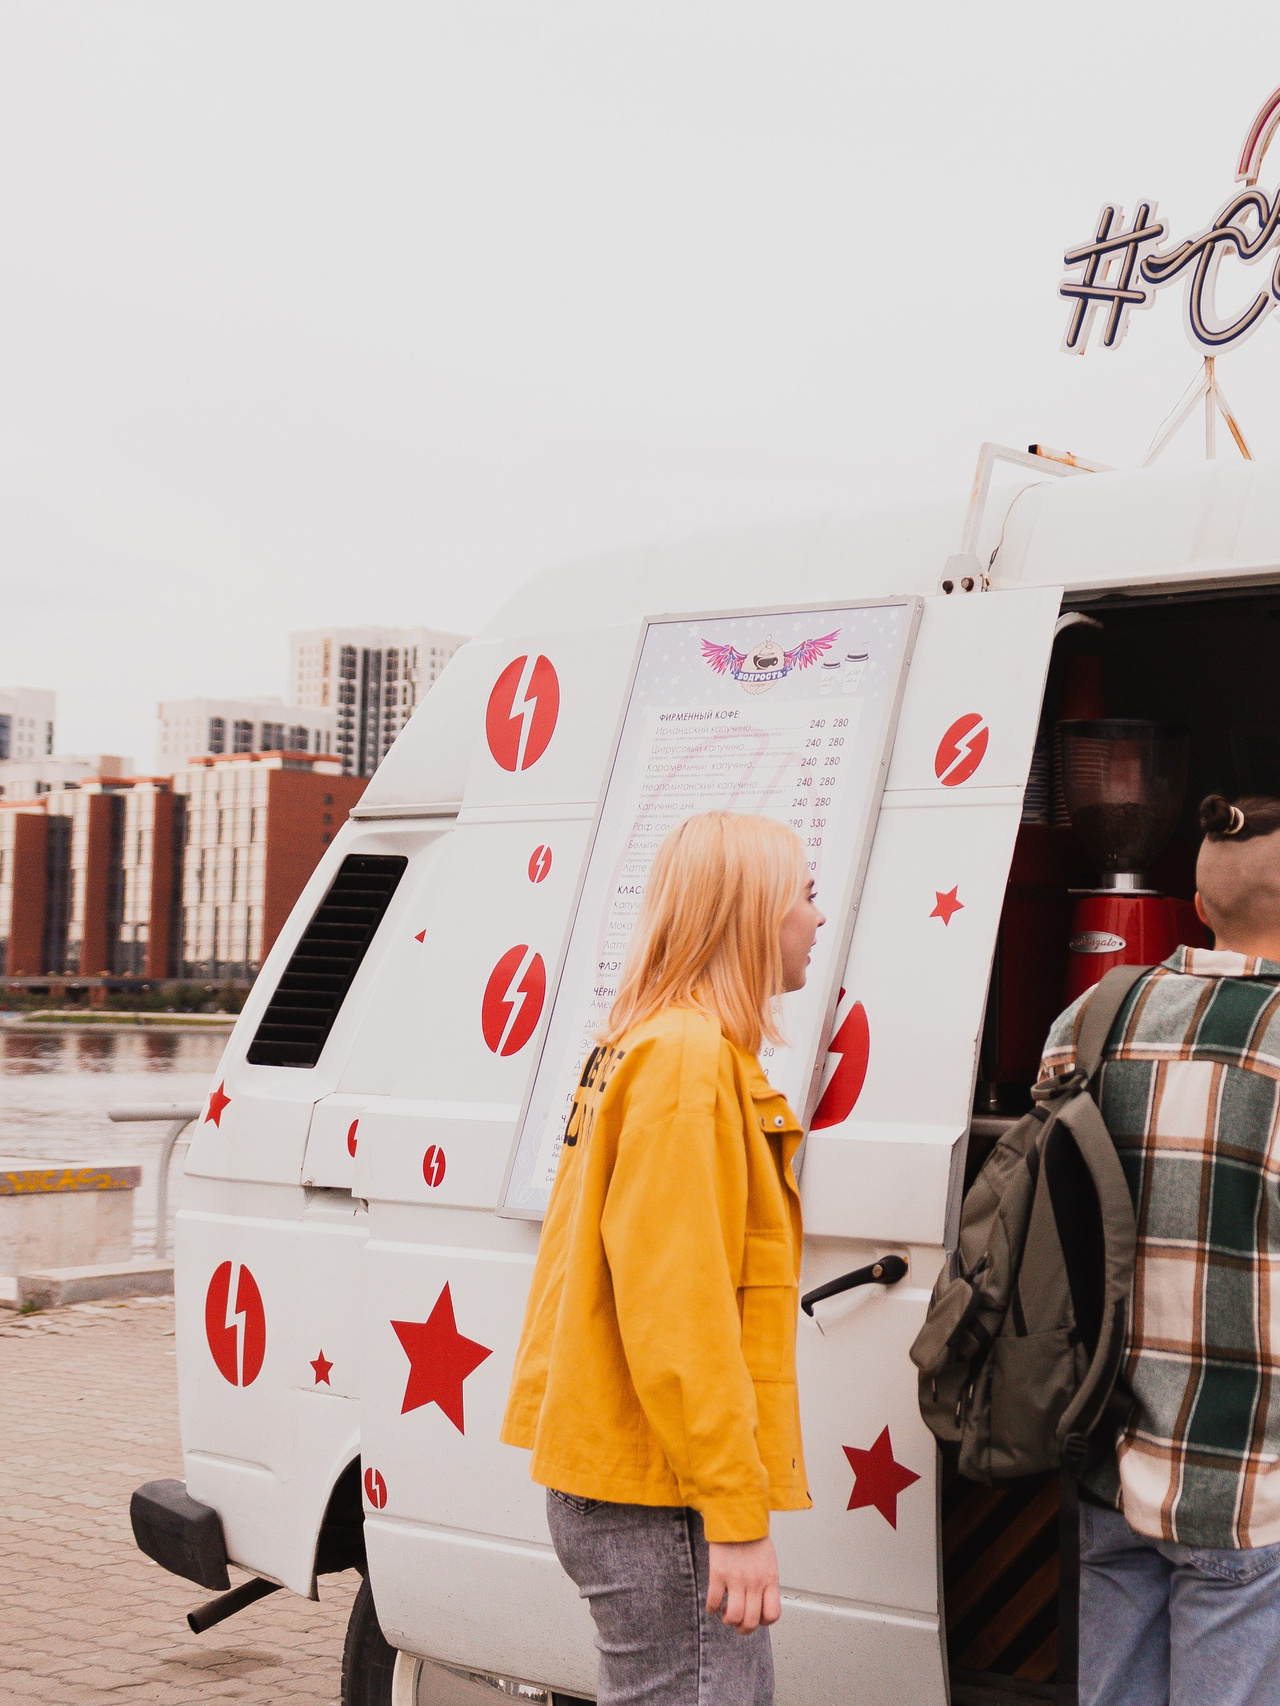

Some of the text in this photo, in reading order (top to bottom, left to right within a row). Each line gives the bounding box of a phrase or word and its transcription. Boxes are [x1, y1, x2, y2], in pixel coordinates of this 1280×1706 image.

[737, 670, 783, 681] БОДРОСТЬ
[659, 709, 713, 721] ФИРМЕННЫЙ
[655, 724, 709, 736] Ирландский
[809, 719, 826, 729] 240
[832, 718, 849, 728] 280
[651, 742, 702, 755] Цитрусовый
[805, 738, 822, 748] 240
[828, 737, 845, 747] 280
[646, 761, 707, 773] Карамельный
[800, 757, 817, 767] 240
[824, 756, 841, 766] 280
[642, 780, 715, 791] Неаполитанский
[796, 777, 813, 787] 240
[819, 776, 836, 786] 280
[637, 801, 678, 811] Капучино
[791, 797, 808, 807] 240
[814, 797, 831, 807] 280
[632, 822, 653, 831] Раф
[810, 818, 827, 828] 330
